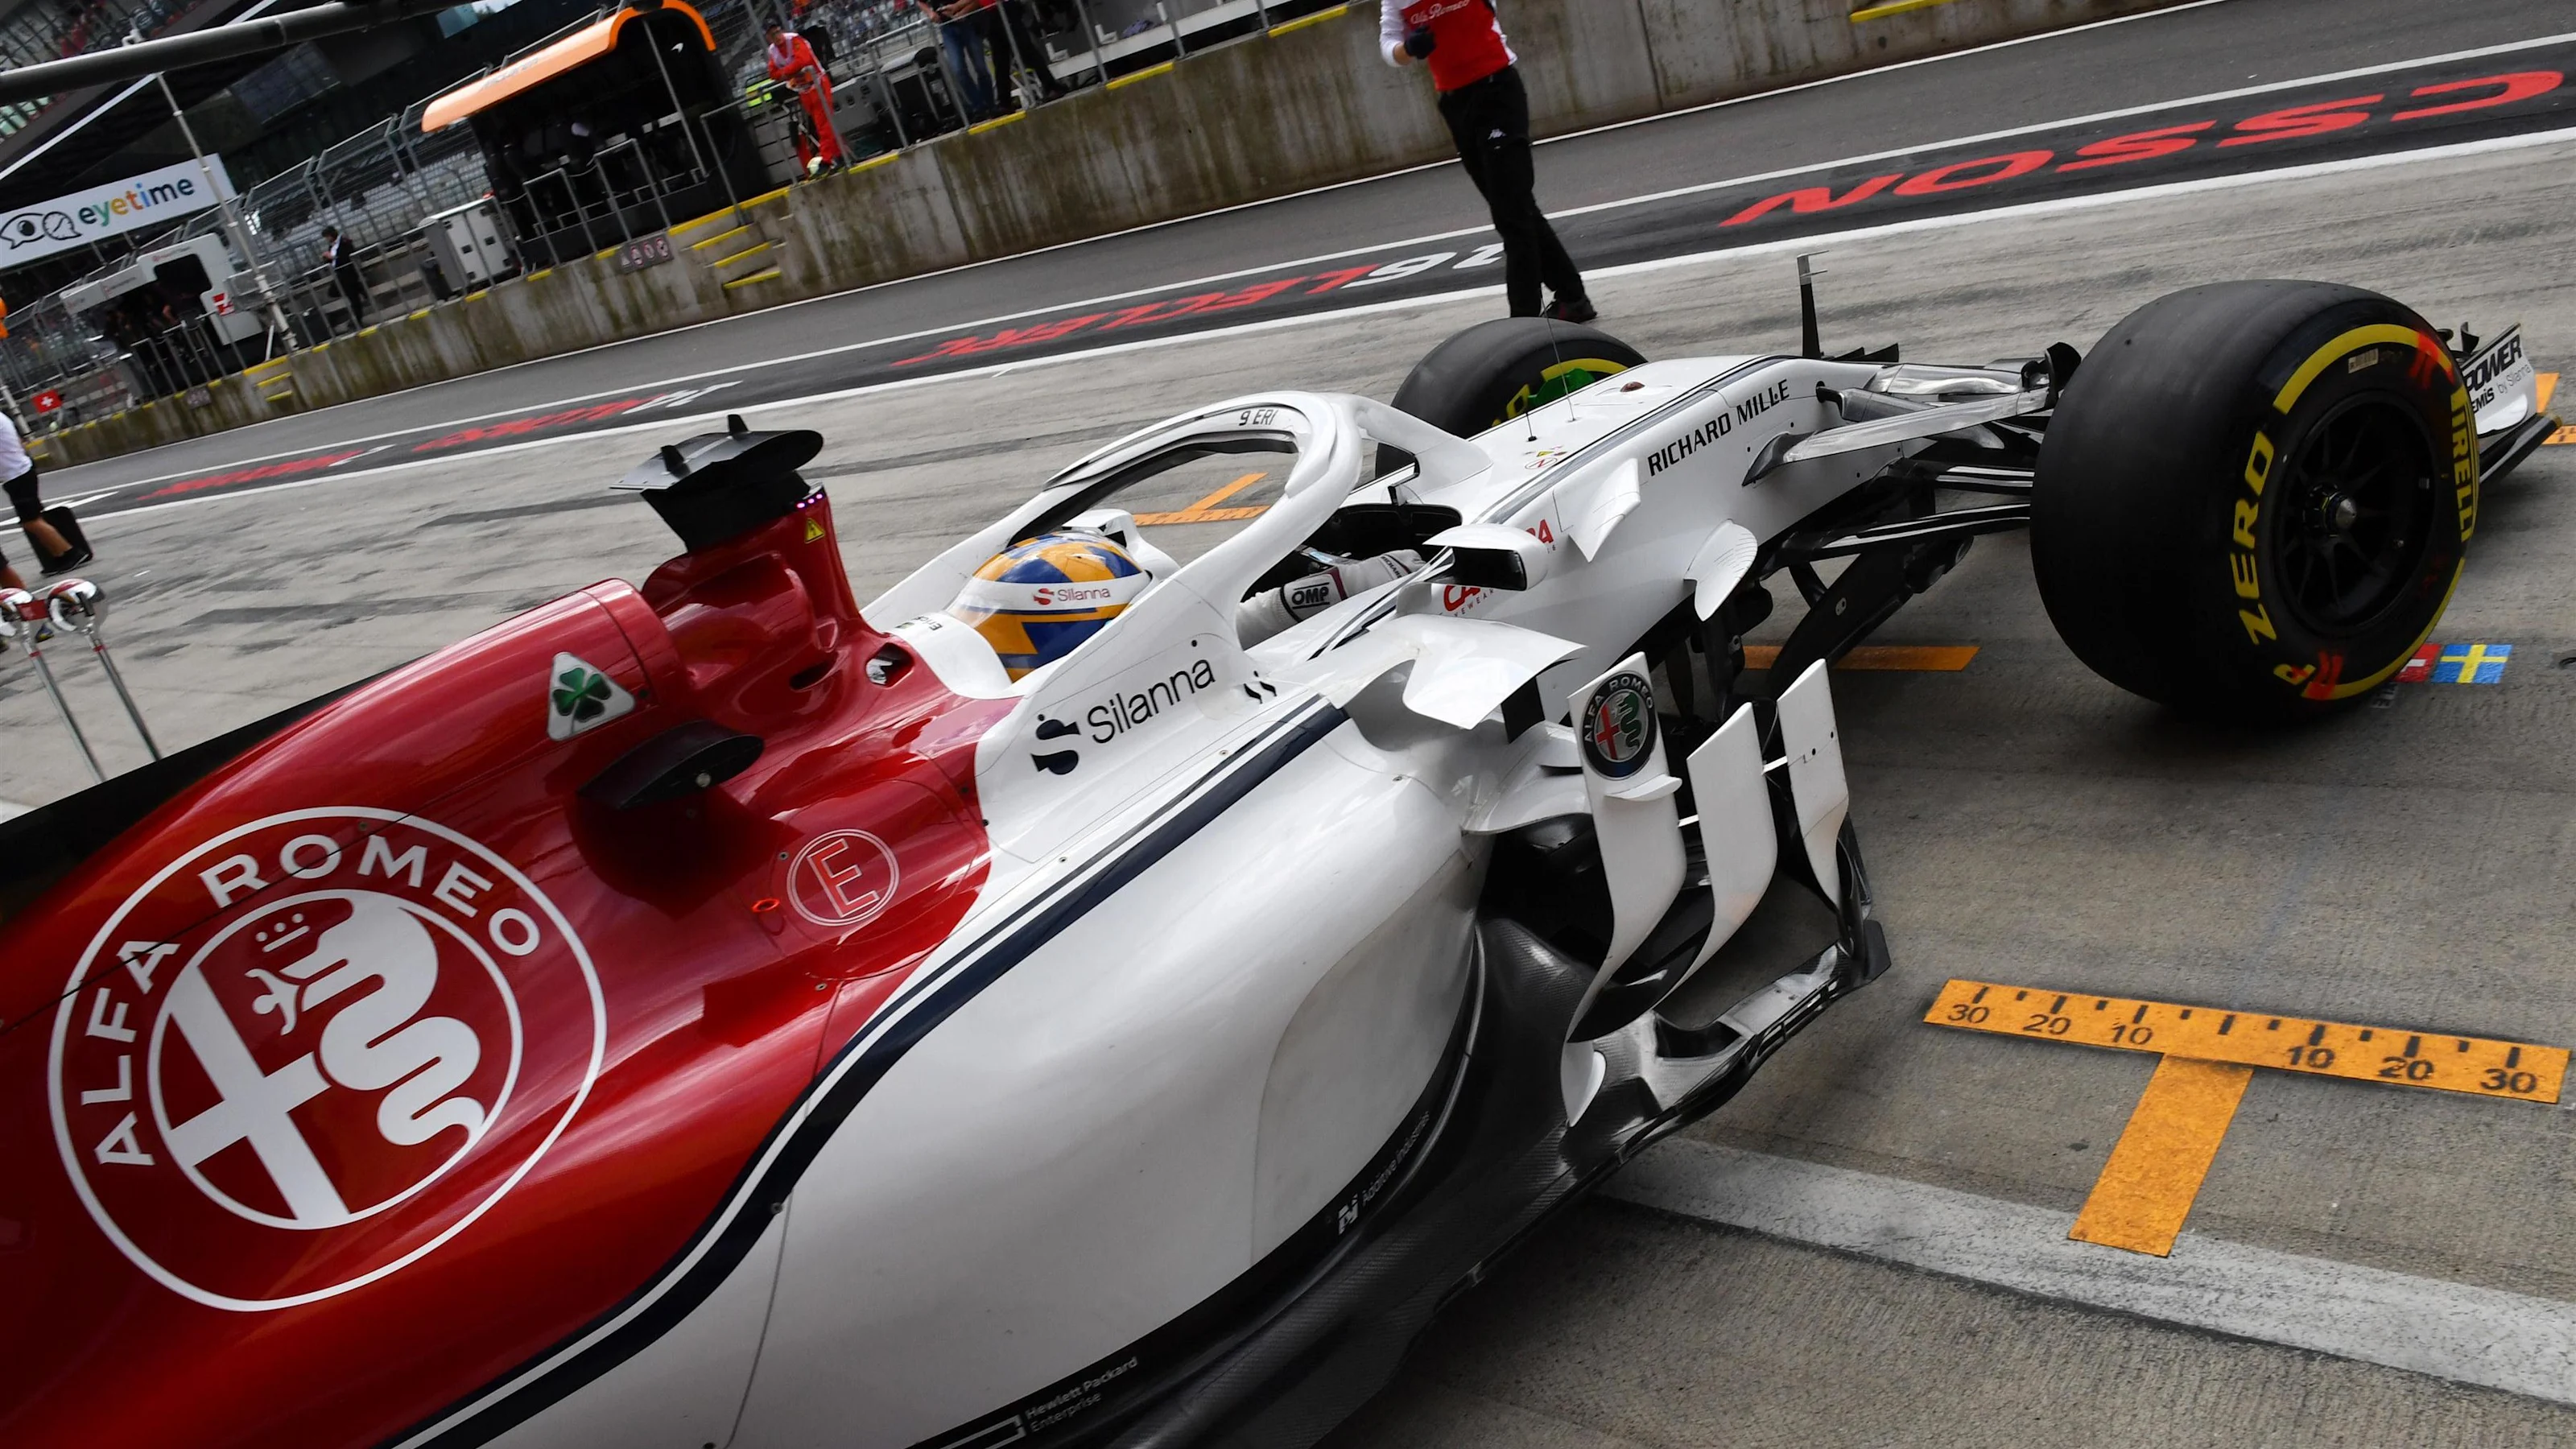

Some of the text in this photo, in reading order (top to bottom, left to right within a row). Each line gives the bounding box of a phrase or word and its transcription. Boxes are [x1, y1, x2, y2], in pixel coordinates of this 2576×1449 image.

[78, 179, 195, 227] eyetime
[1239, 409, 1278, 426] 9 ERI
[1647, 378, 1790, 477] RICHARD MILLE
[2229, 431, 2277, 646] ZERO
[1057, 585, 1112, 602] Silanna
[1291, 586, 1329, 605] OMP
[1087, 658, 1216, 745] Silanna
[1584, 676, 1653, 742] ALFA ROMEO
[81, 834, 540, 1166] ALFA ROMEO
[1946, 1002, 2538, 1095] 30 20 10 10 20 30
[1025, 1356, 1139, 1420] Hewlett Packard
[1030, 1392, 1103, 1433] Enterprise
